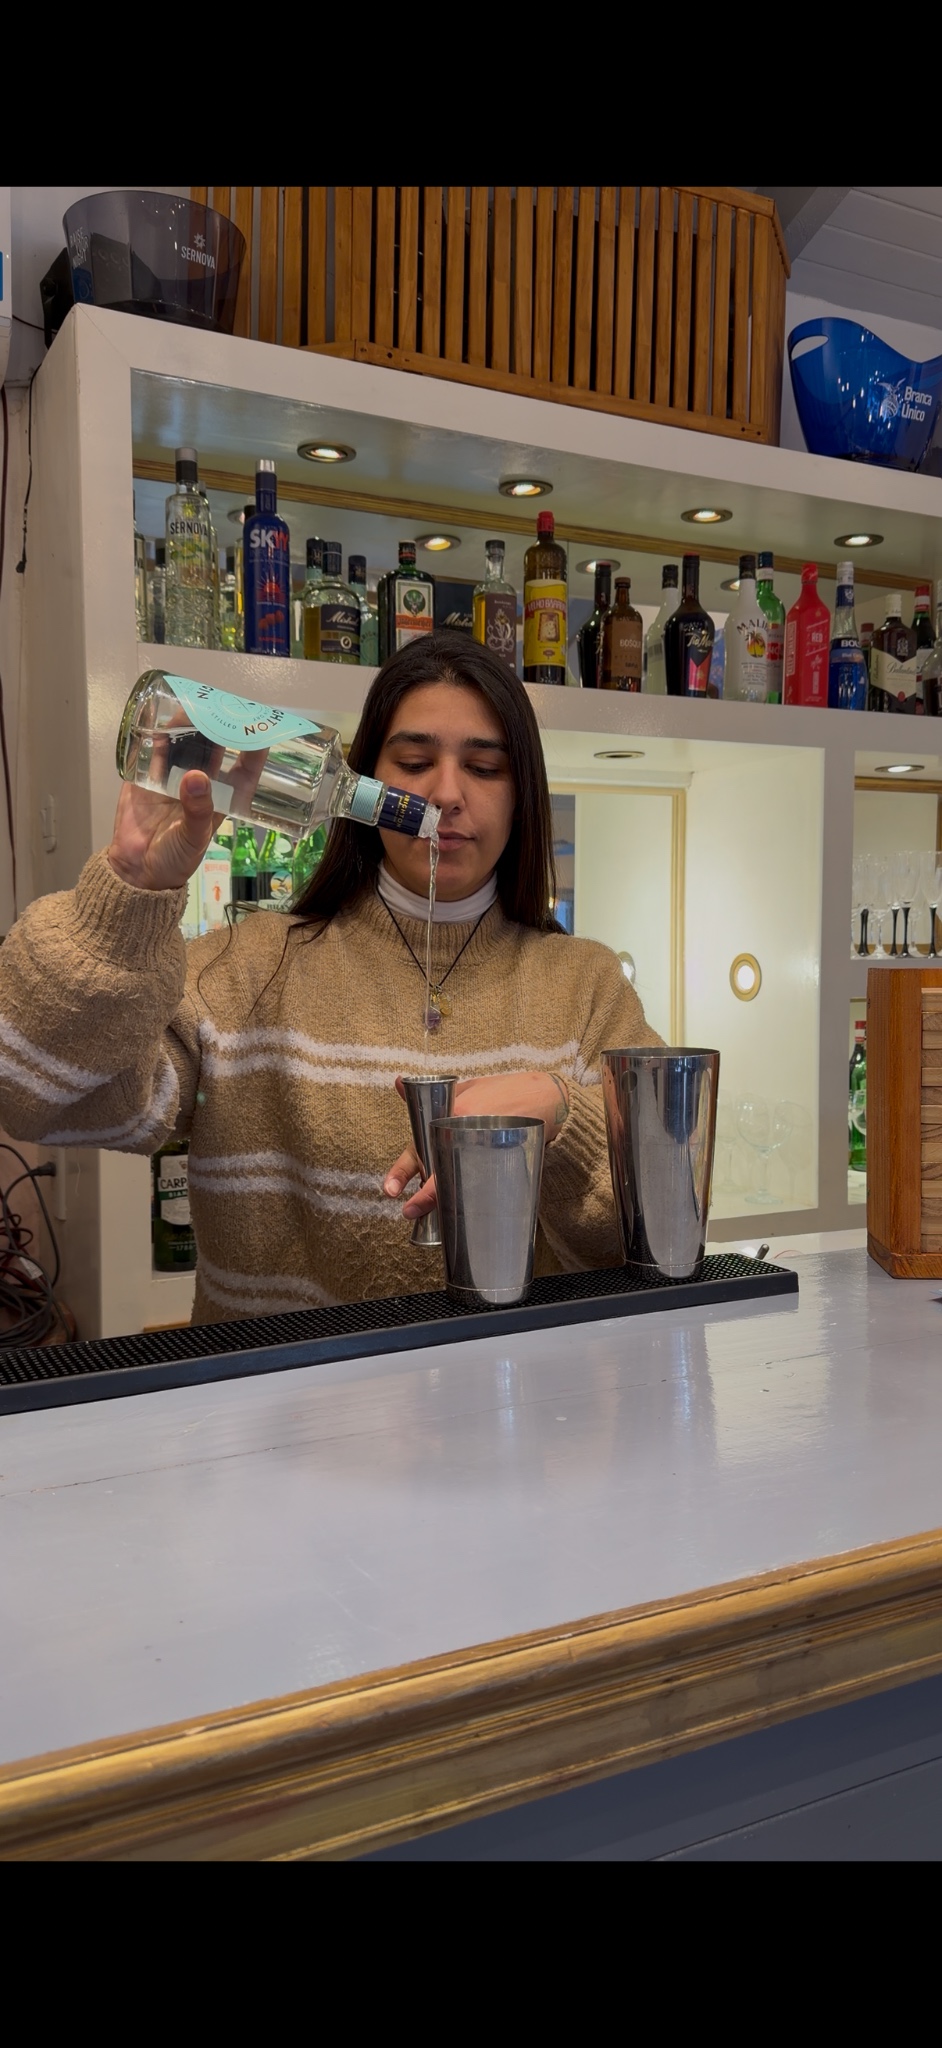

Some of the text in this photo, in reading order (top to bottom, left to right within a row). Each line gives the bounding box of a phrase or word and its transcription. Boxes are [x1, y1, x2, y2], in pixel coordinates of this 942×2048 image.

[181, 246, 216, 269] SERNOVA
[904, 386, 932, 406] Branca
[901, 401, 925, 422] Único
[170, 521, 208, 536] SERNOVA
[250, 529, 289, 552] SKYY
[207, 706, 237, 730] DSTILLED
[160, 1177, 187, 1189] CARP
